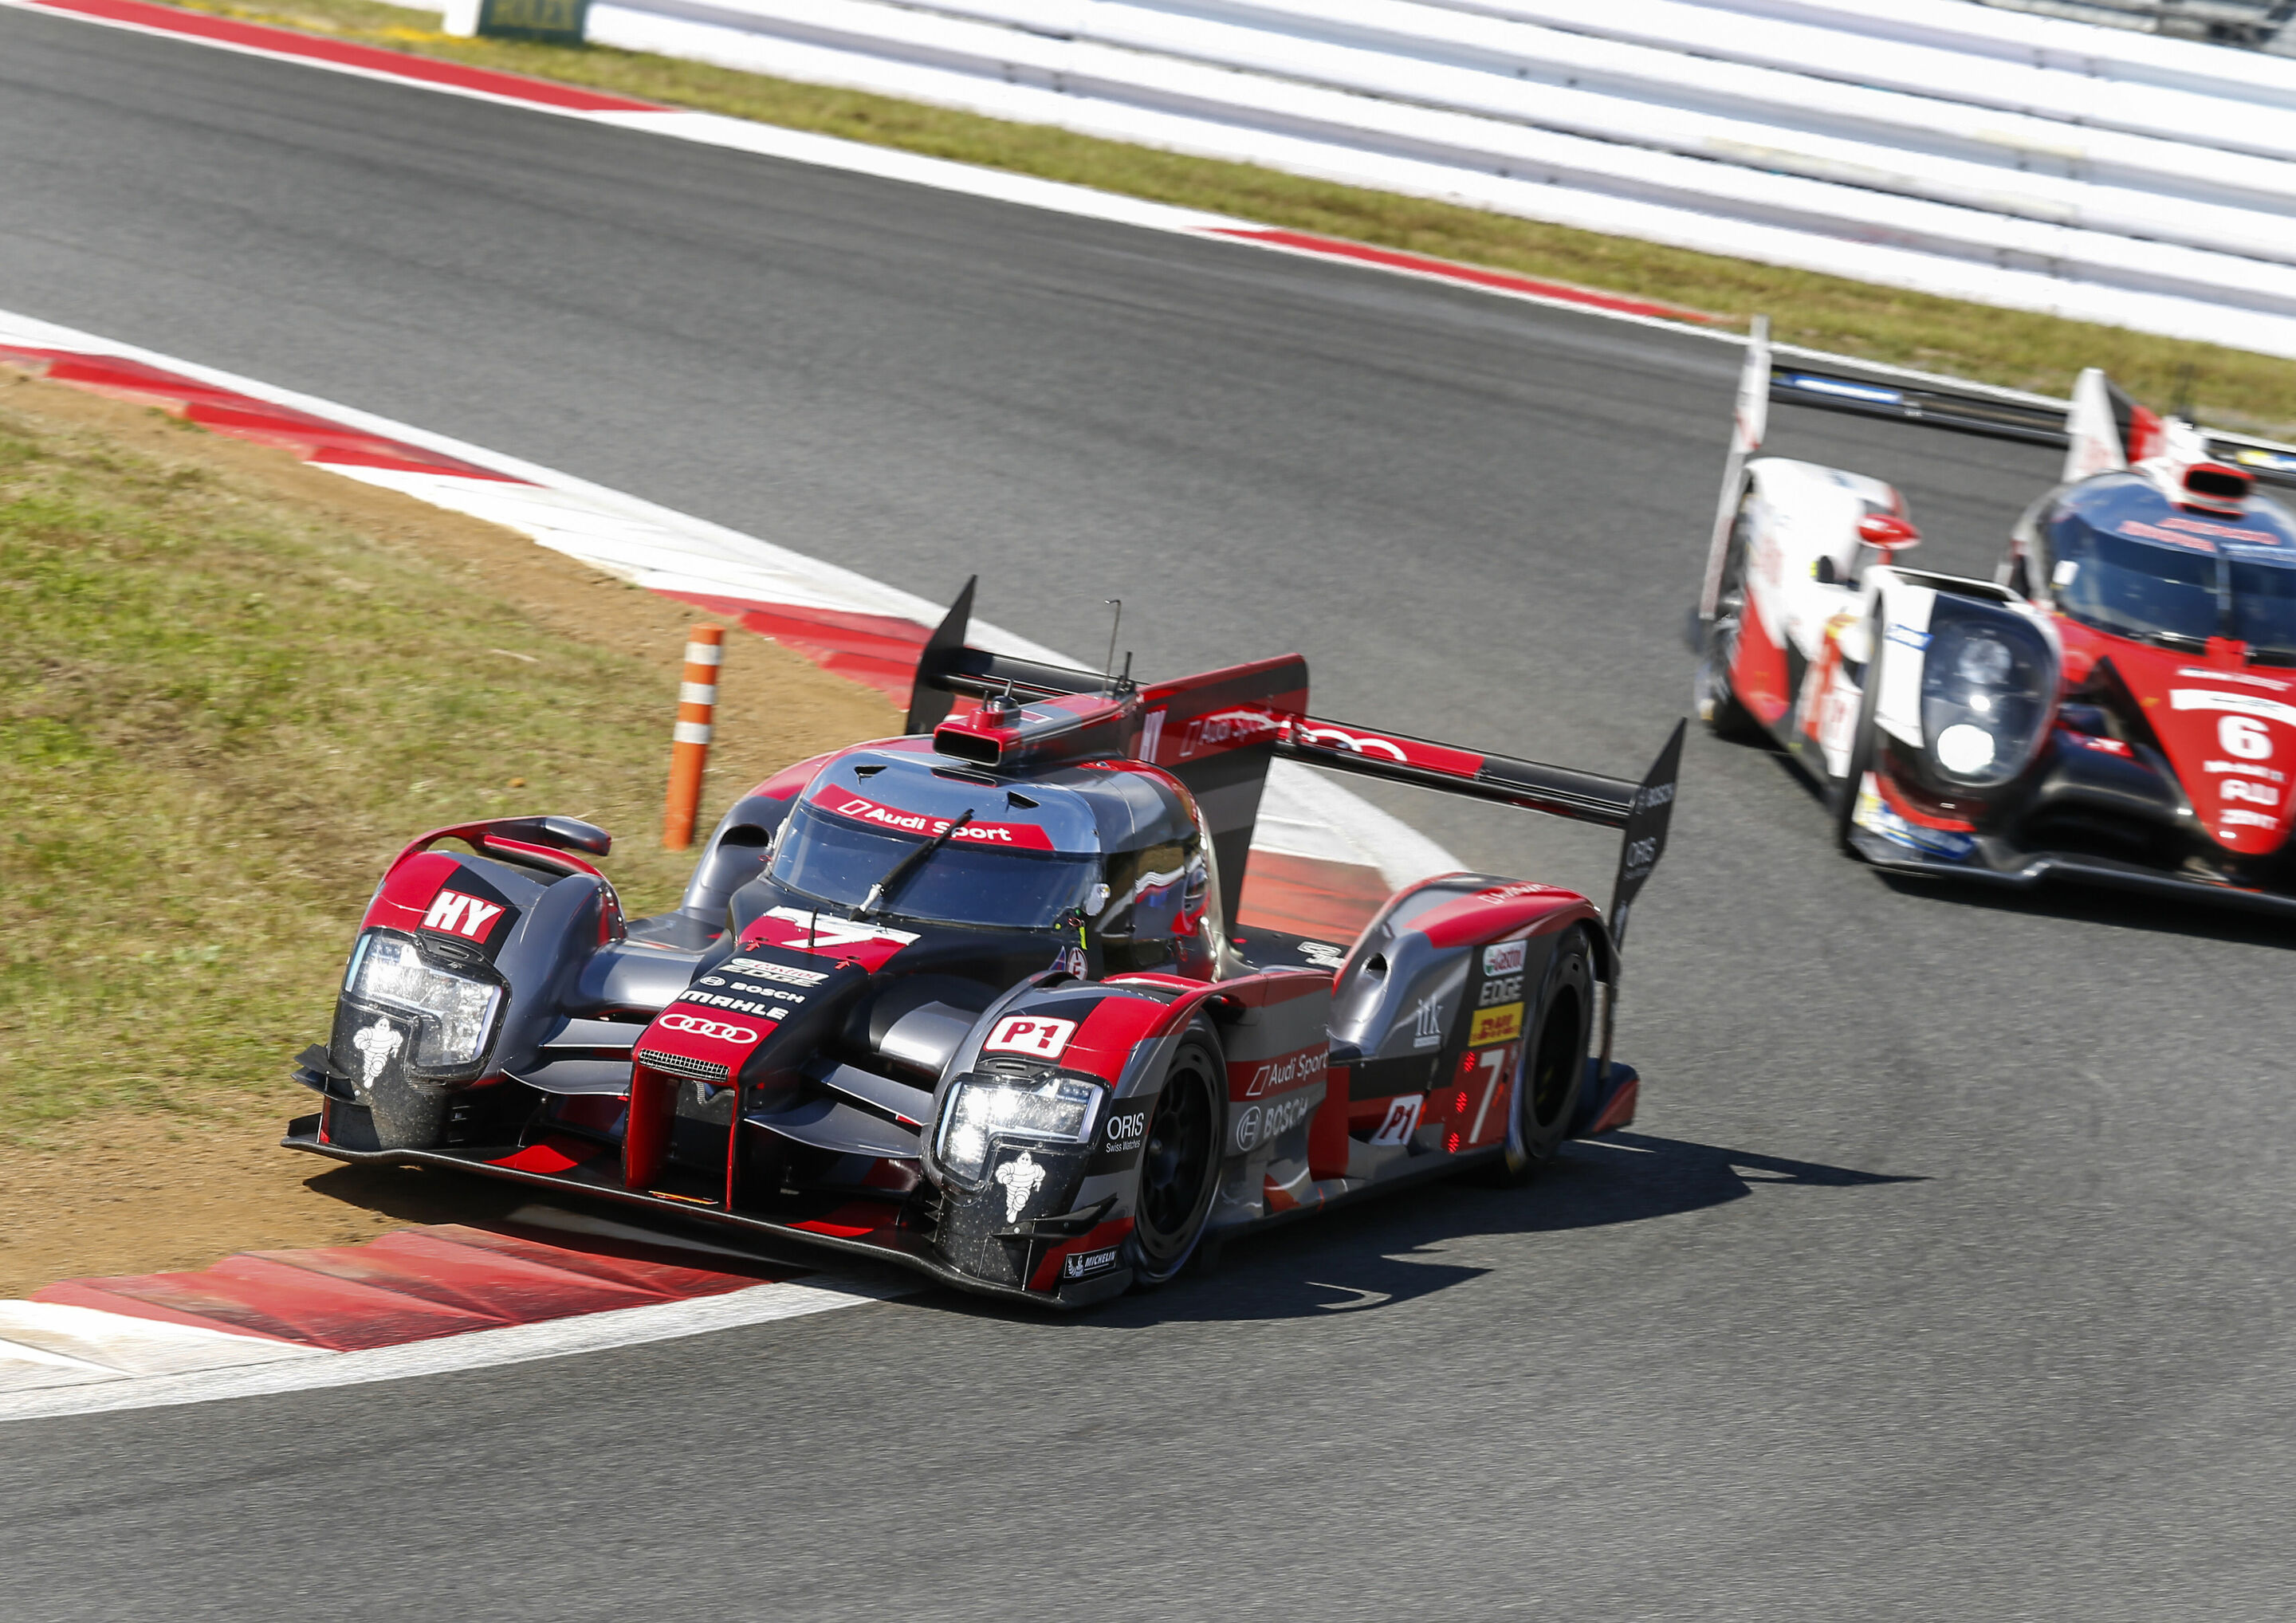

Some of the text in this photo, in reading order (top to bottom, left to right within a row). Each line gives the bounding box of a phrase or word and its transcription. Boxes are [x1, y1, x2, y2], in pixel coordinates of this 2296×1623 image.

[2218, 715, 2273, 760] 6
[865, 808, 1012, 842] Audi Sport
[423, 891, 501, 937] HY
[759, 906, 922, 948] 7
[718, 964, 823, 988] EDGE
[754, 962, 818, 980] Castrol
[679, 990, 790, 1021] MAHLE
[729, 981, 805, 1004] BOSCH
[1479, 976, 1525, 1007] EDGE
[1001, 1022, 1059, 1048] P1
[1268, 1048, 1329, 1087] Audi Sport
[1468, 1049, 1505, 1144] 7
[1107, 1112, 1144, 1140] ORIS
[1263, 1097, 1308, 1139] BOSCH
[1380, 1103, 1416, 1140] P1
[1106, 1142, 1122, 1153] Swiss
[1085, 1250, 1116, 1267] MICHELIN
